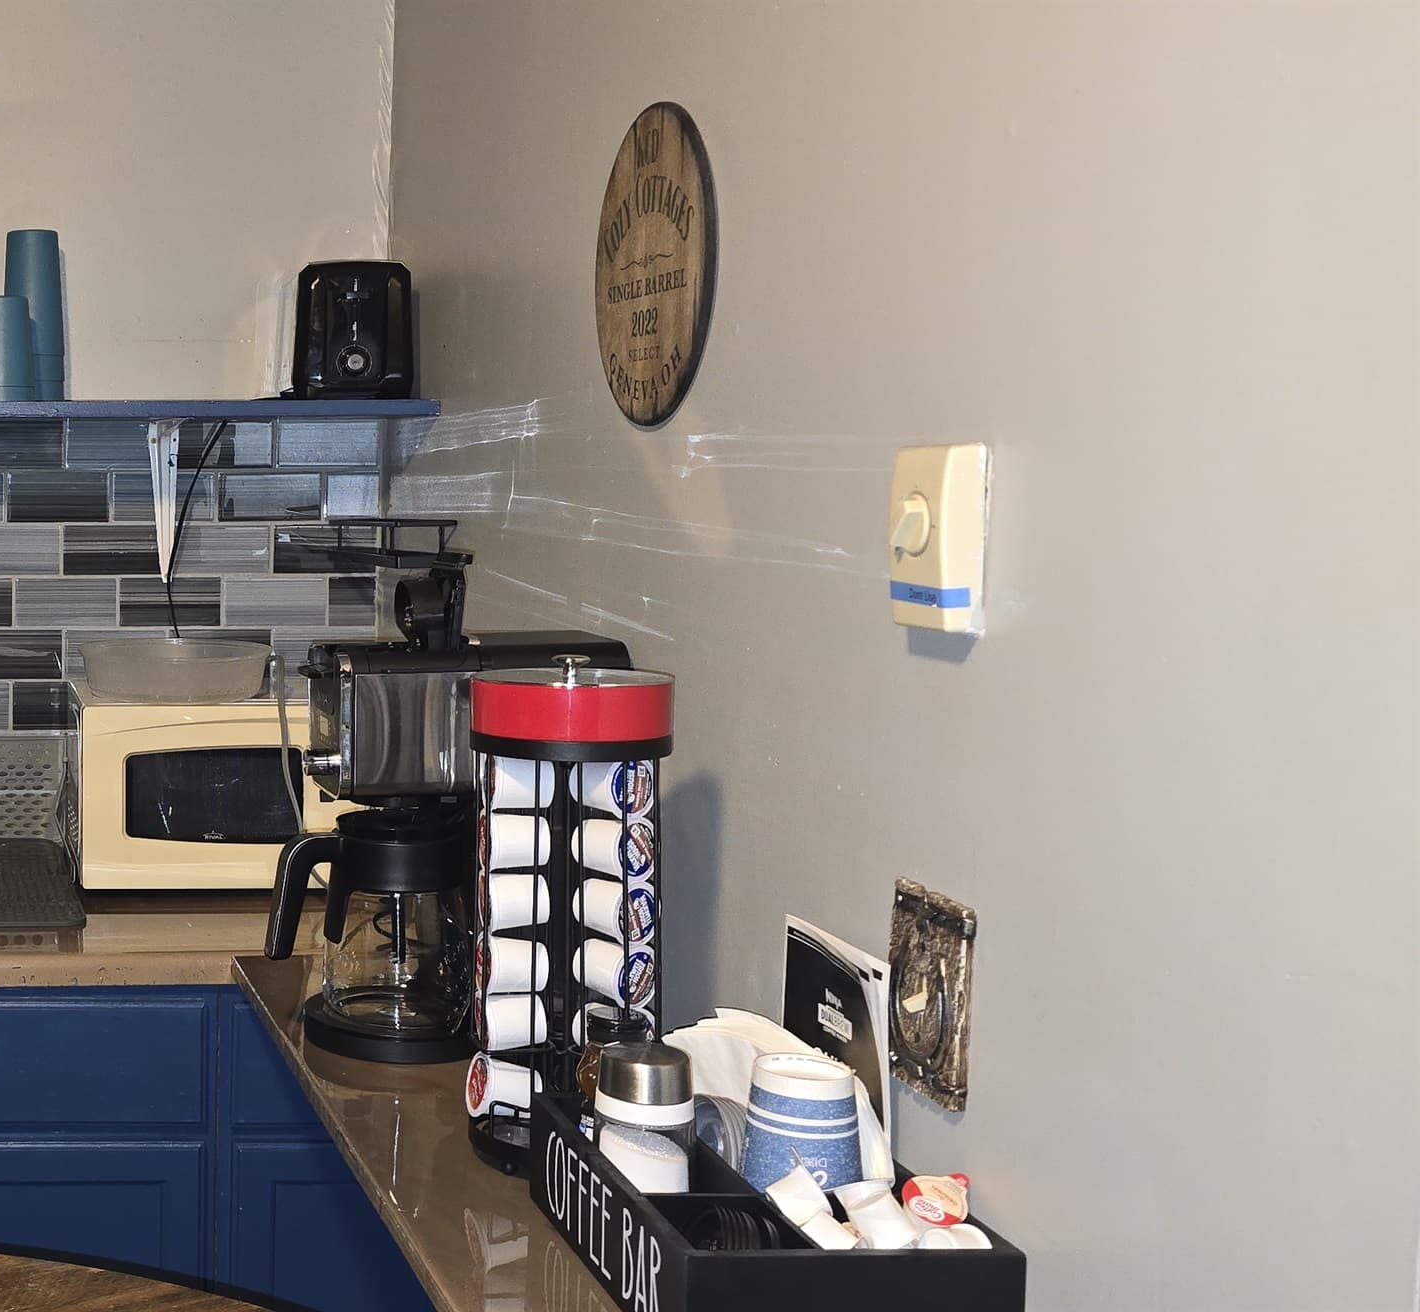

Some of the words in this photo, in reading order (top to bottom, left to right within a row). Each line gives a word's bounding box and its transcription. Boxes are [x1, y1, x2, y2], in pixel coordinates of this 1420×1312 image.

[644, 268, 687, 296] BARREL
[632, 307, 658, 338] 2022
[628, 345, 660, 362] SELECT
[546, 1131, 612, 1281] COFFEE
[621, 1207, 661, 1312] BAR
